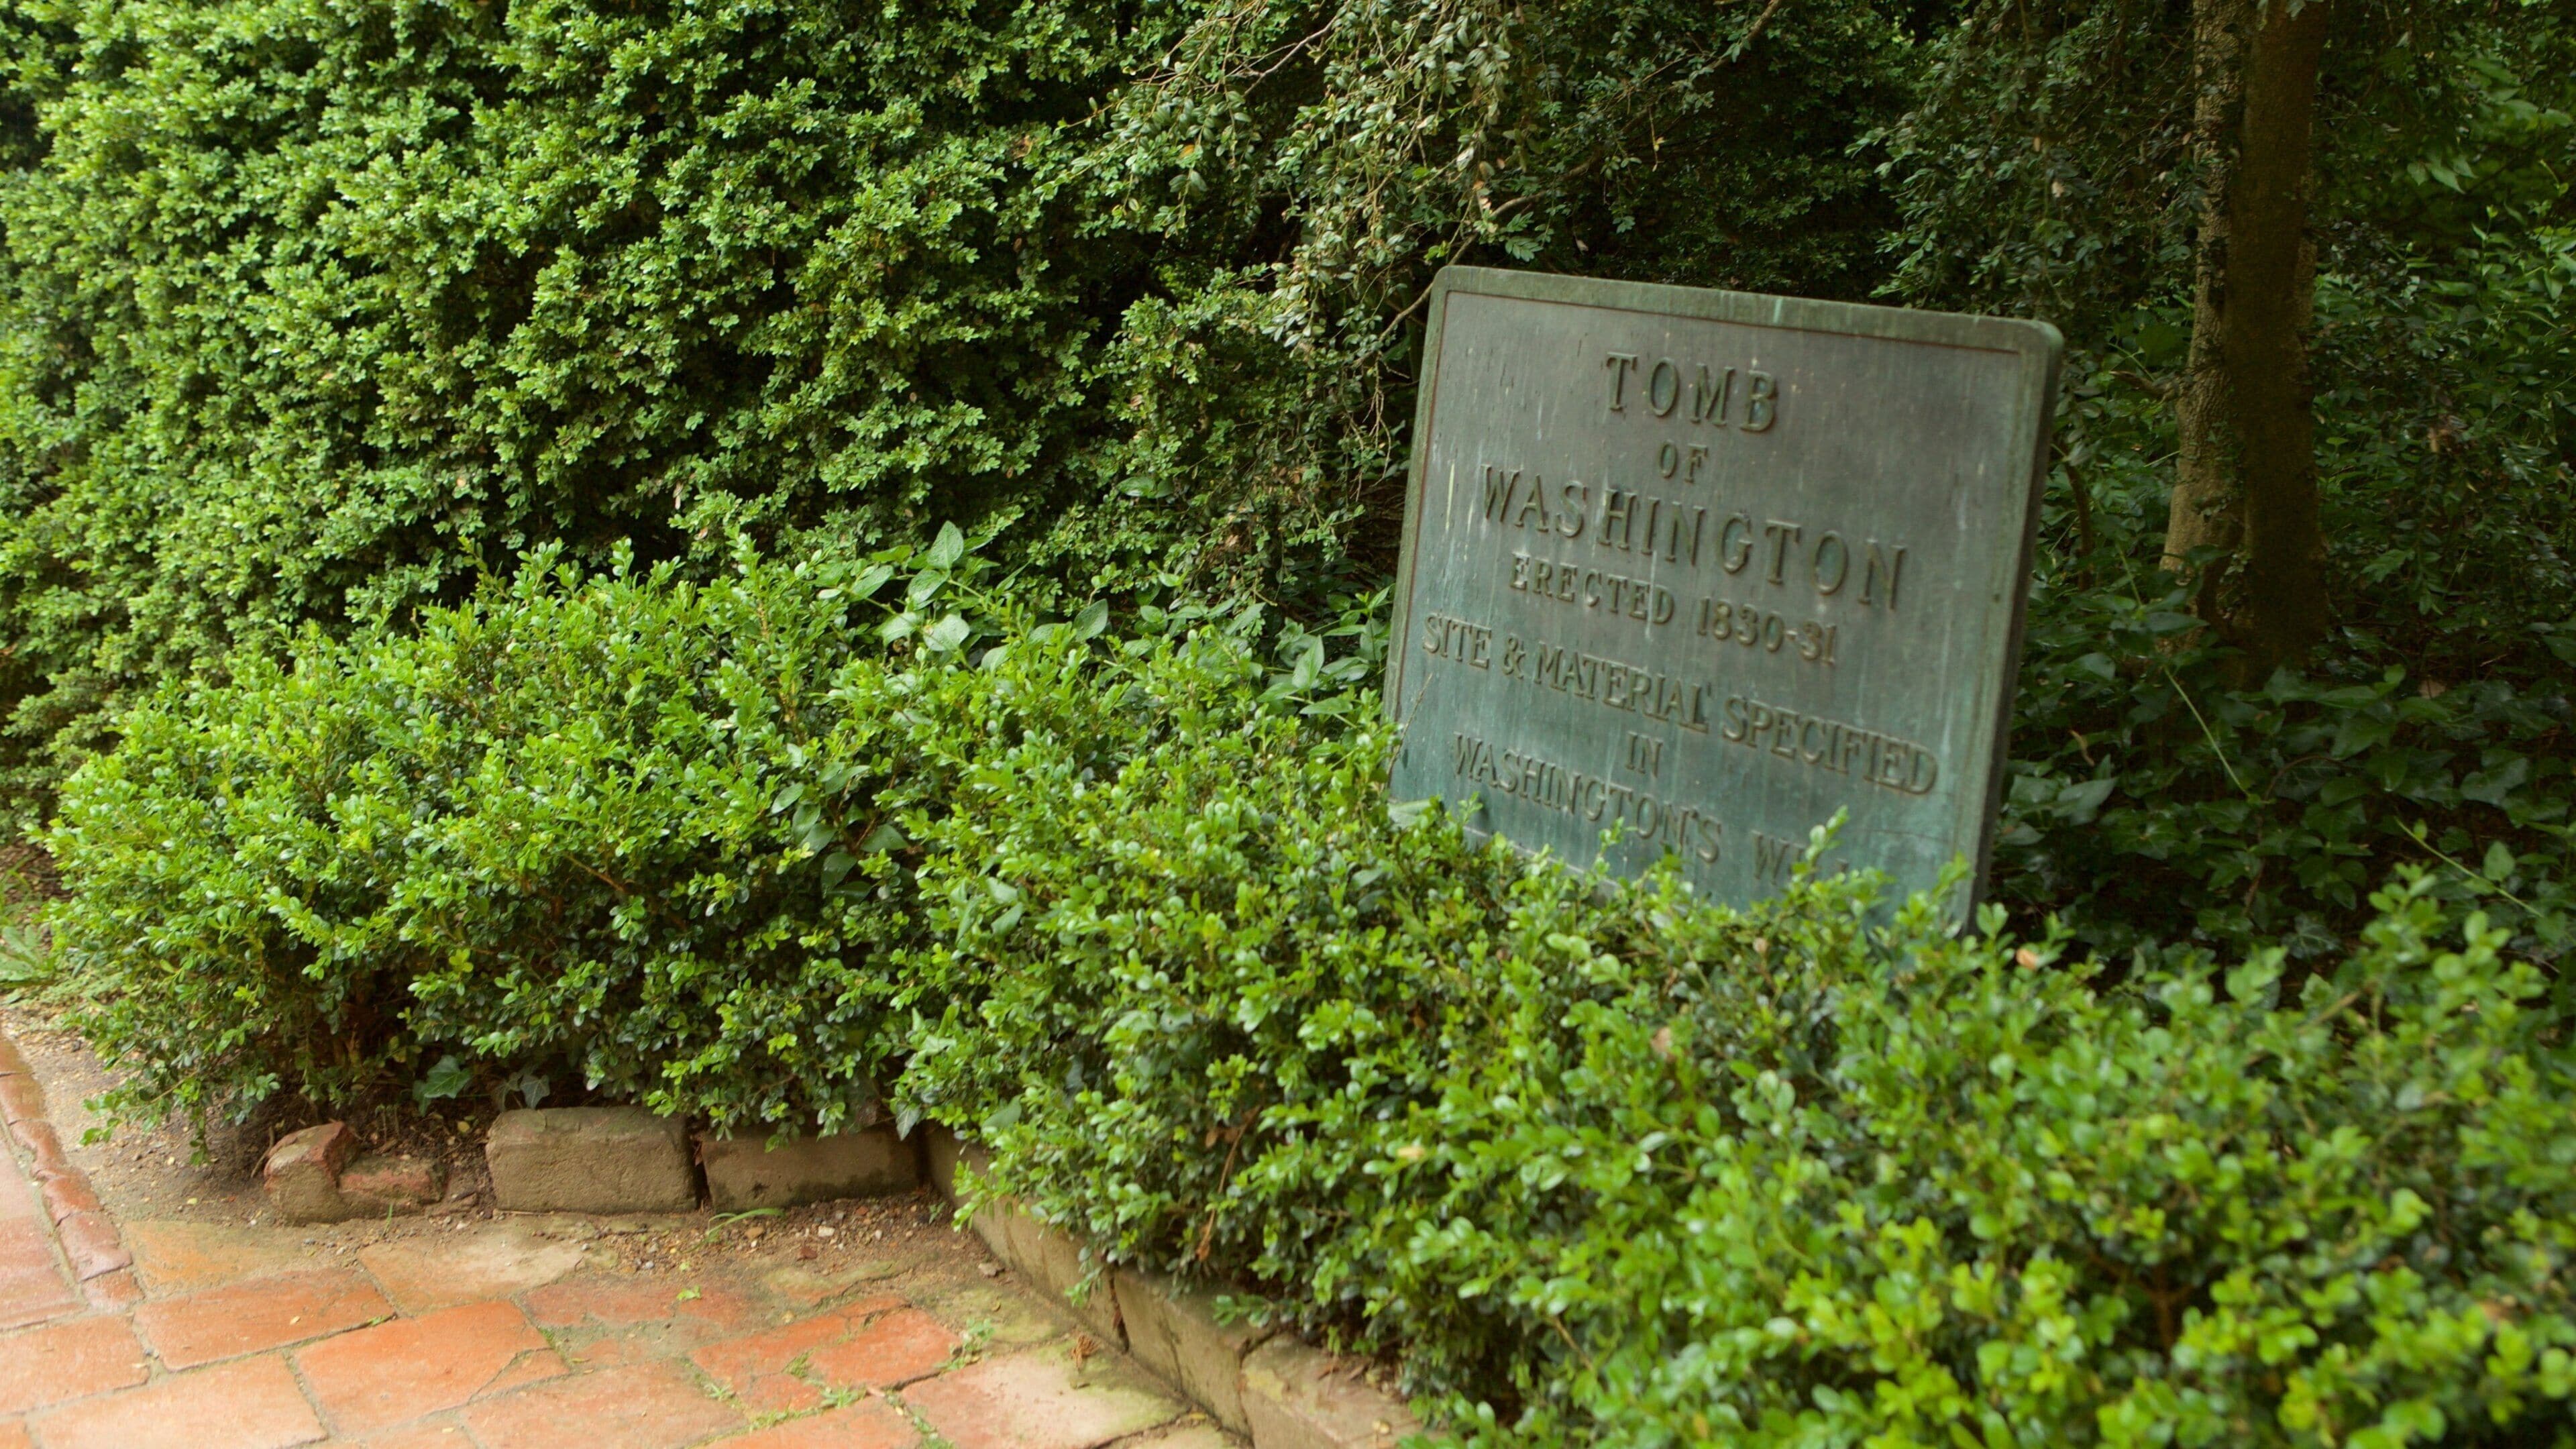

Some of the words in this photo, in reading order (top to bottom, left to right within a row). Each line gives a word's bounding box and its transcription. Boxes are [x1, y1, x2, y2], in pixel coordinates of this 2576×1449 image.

[1606, 352, 1780, 434] TOMB
[1657, 439, 1710, 483] OF
[1479, 464, 1909, 610] WASHINGTON
[1509, 551, 1676, 626] ERECTED
[1697, 596, 1838, 667] 1830-31
[1422, 611, 1492, 669] SITE
[1501, 633, 1527, 680] &
[1533, 641, 1710, 734] MATERIAL
[1722, 694, 1939, 796] SPECIFIED
[1625, 731, 1664, 778] IN
[1453, 731, 1723, 864] WASHINGTON'S
